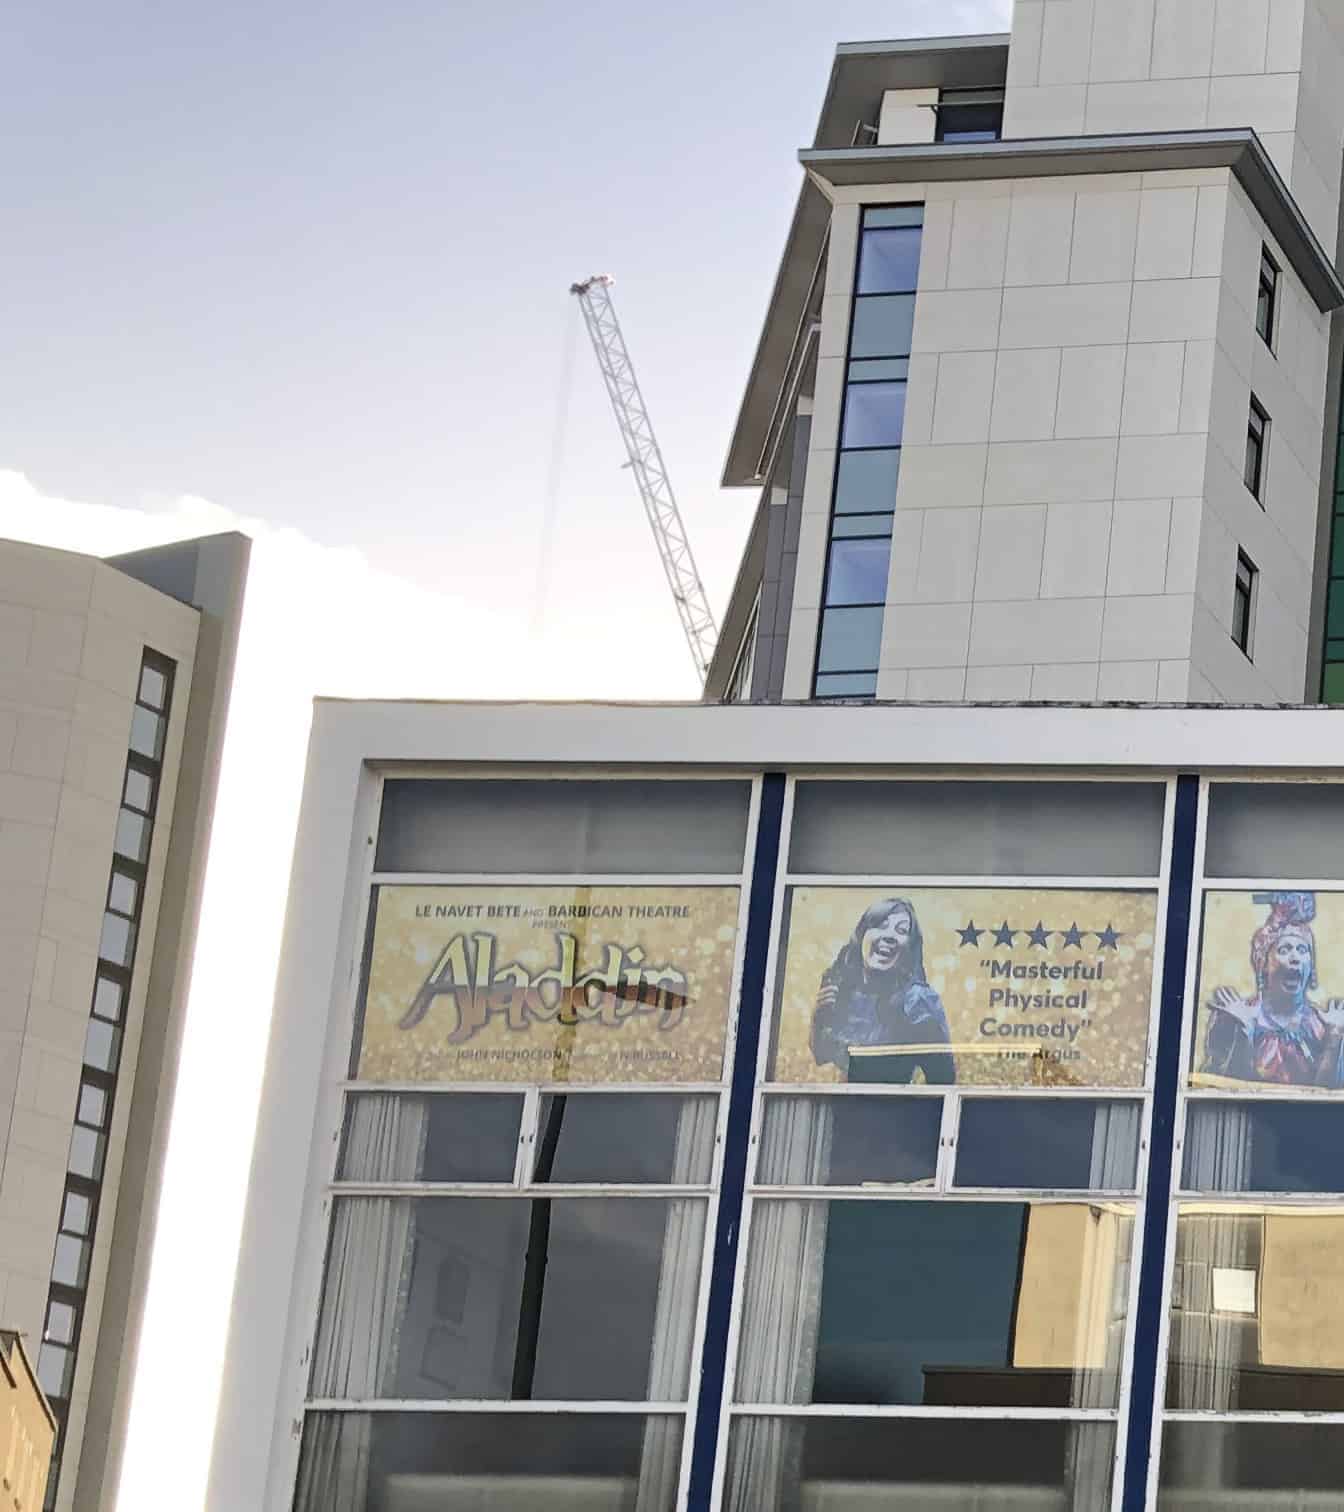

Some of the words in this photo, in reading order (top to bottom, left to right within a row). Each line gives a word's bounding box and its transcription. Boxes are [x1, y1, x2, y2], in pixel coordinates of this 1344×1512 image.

[415, 905, 433, 918] LE
[436, 904, 483, 918] NAVET
[486, 904, 521, 918] BETE
[548, 904, 623, 918] BARBICAN
[627, 905, 690, 918] THEATRE
[398, 930, 690, 1045] Aladdin
[988, 988, 1088, 1012] Physical
